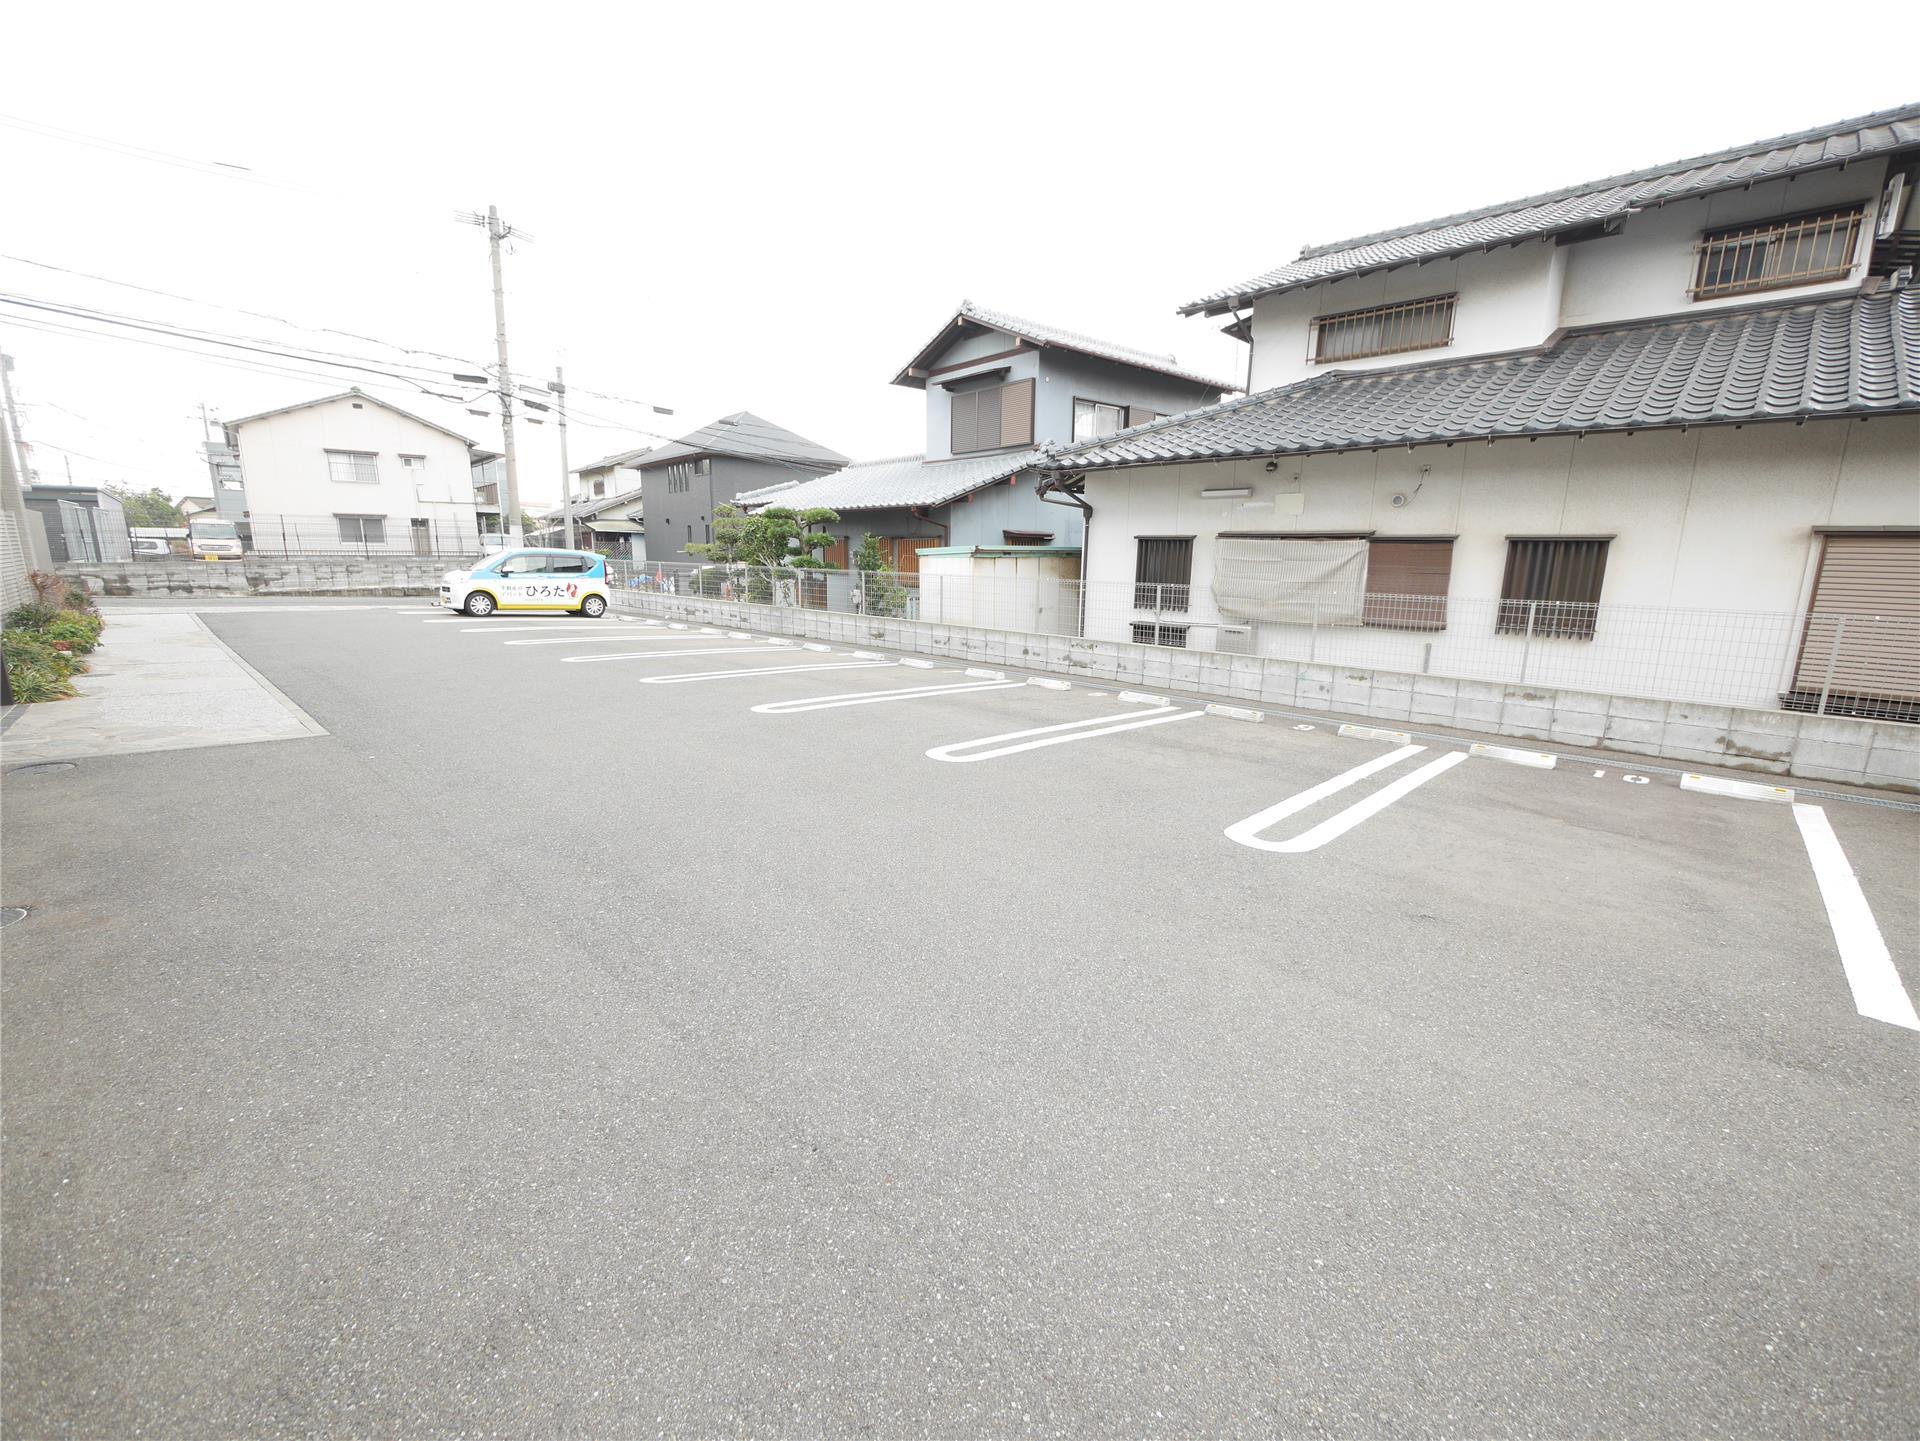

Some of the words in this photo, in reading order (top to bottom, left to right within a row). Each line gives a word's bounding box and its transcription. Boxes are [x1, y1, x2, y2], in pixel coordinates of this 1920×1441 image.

[525, 585, 565, 597] ひろた
[1592, 769, 1650, 784] 10
